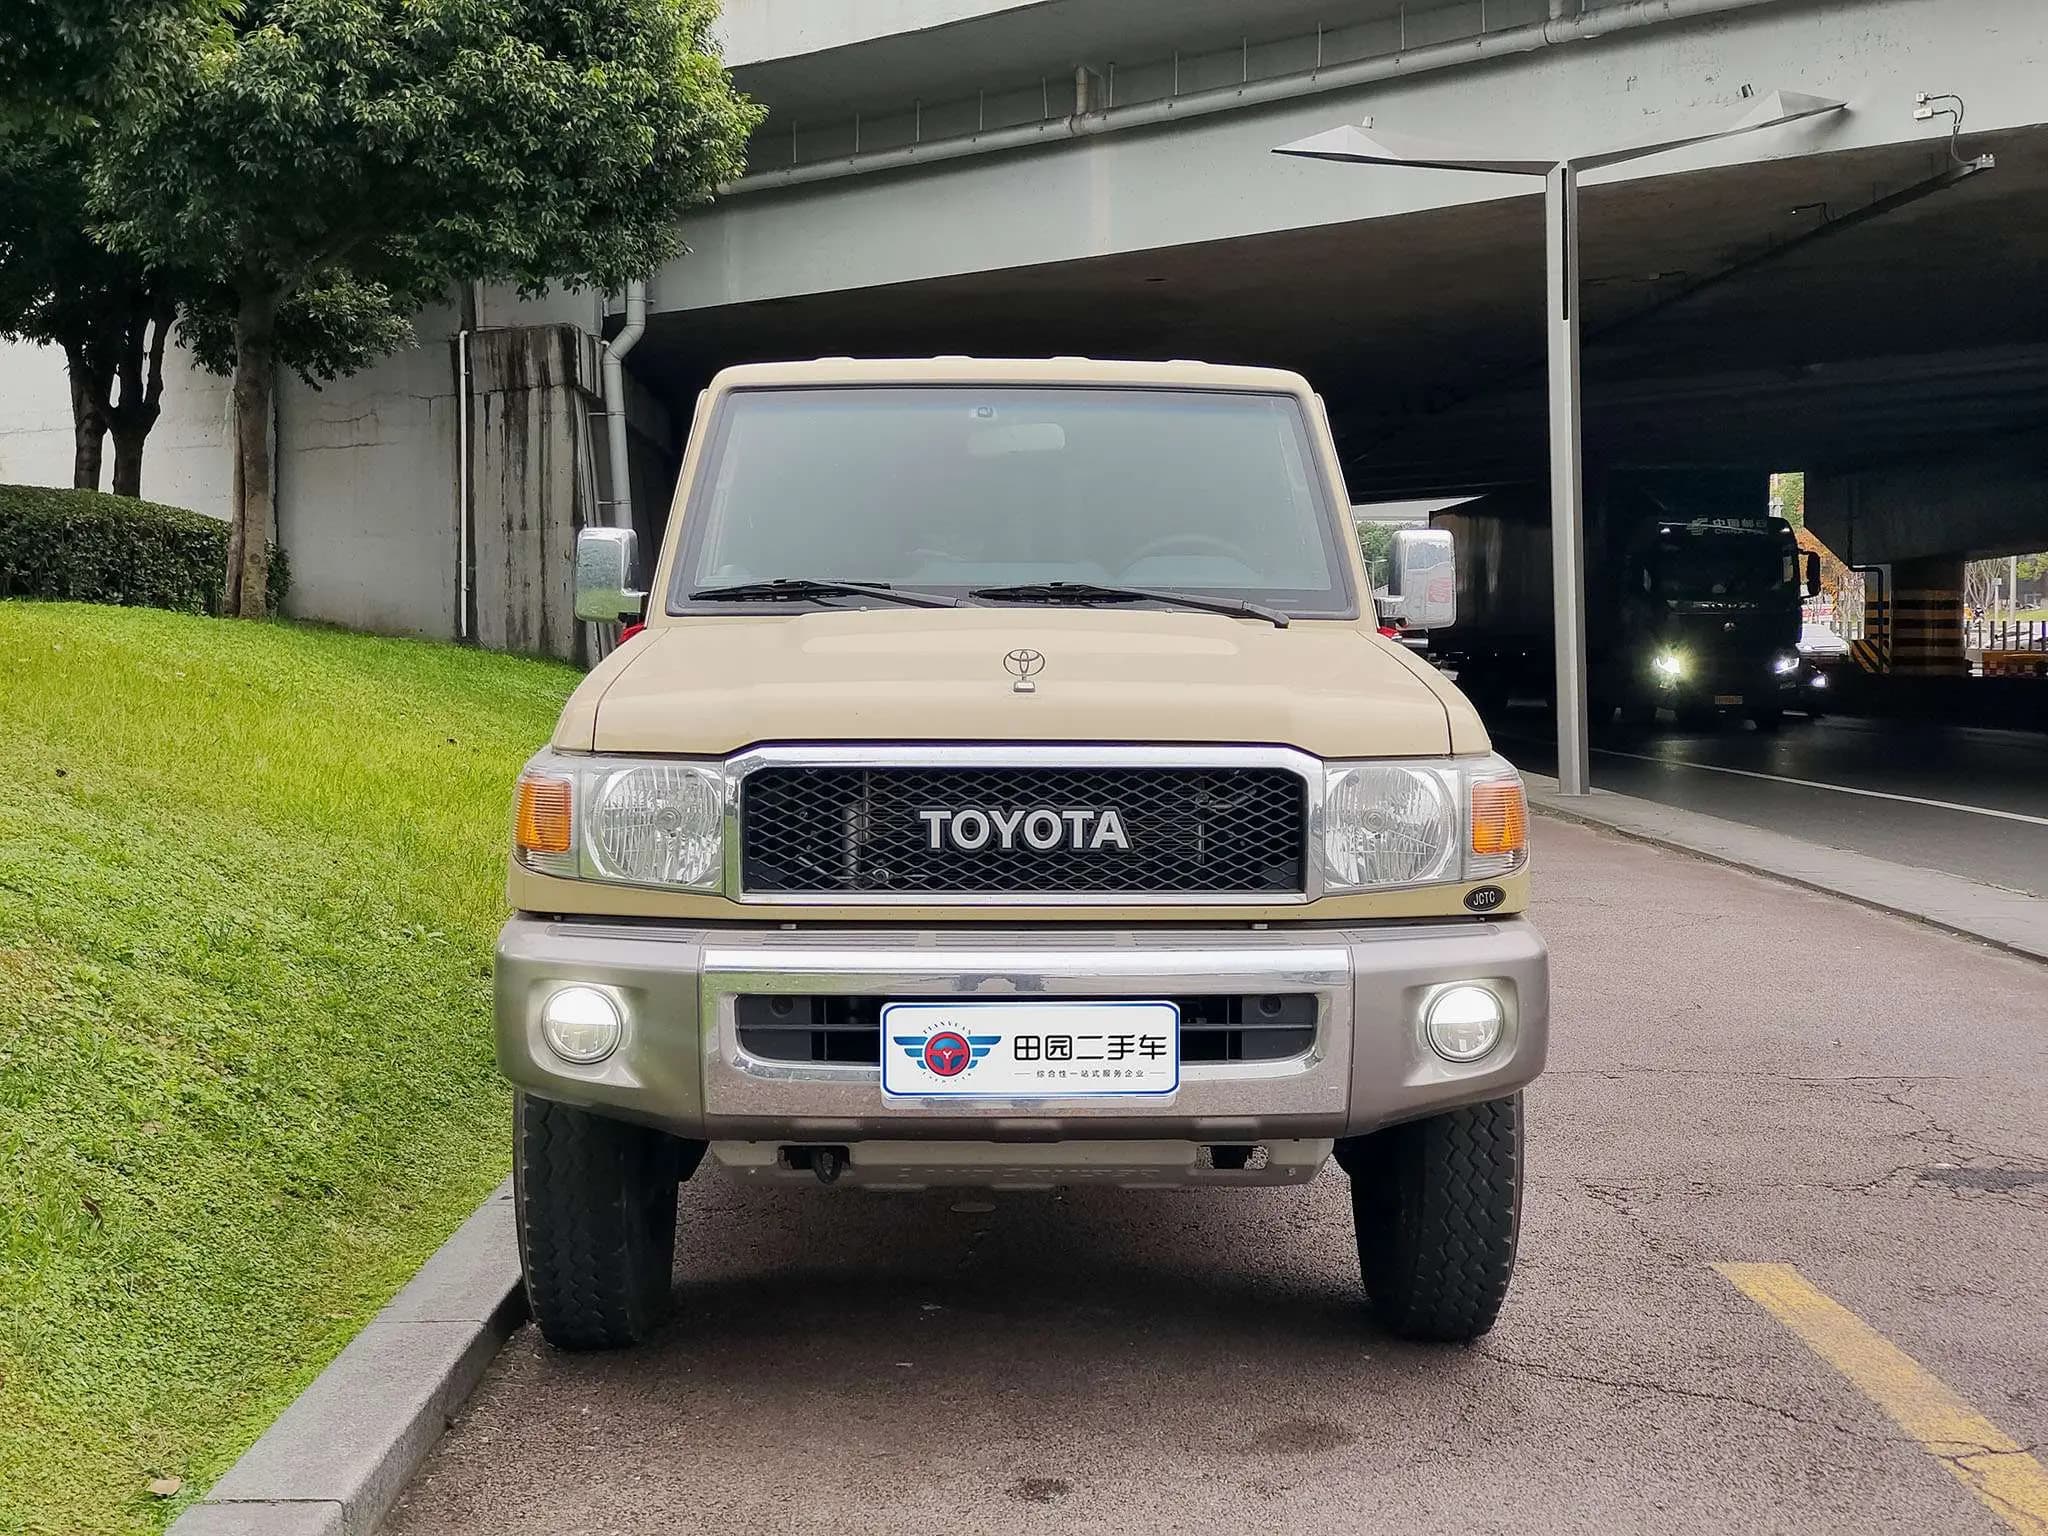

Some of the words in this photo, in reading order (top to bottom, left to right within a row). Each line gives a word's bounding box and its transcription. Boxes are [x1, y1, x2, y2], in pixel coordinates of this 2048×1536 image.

[919, 809, 1130, 849] TOYOTA
[1473, 890, 1496, 906] JCTC
[1014, 1034, 1167, 1061] 田园二手车
[1036, 1069, 1144, 1078] 综合性一站式服务企业
